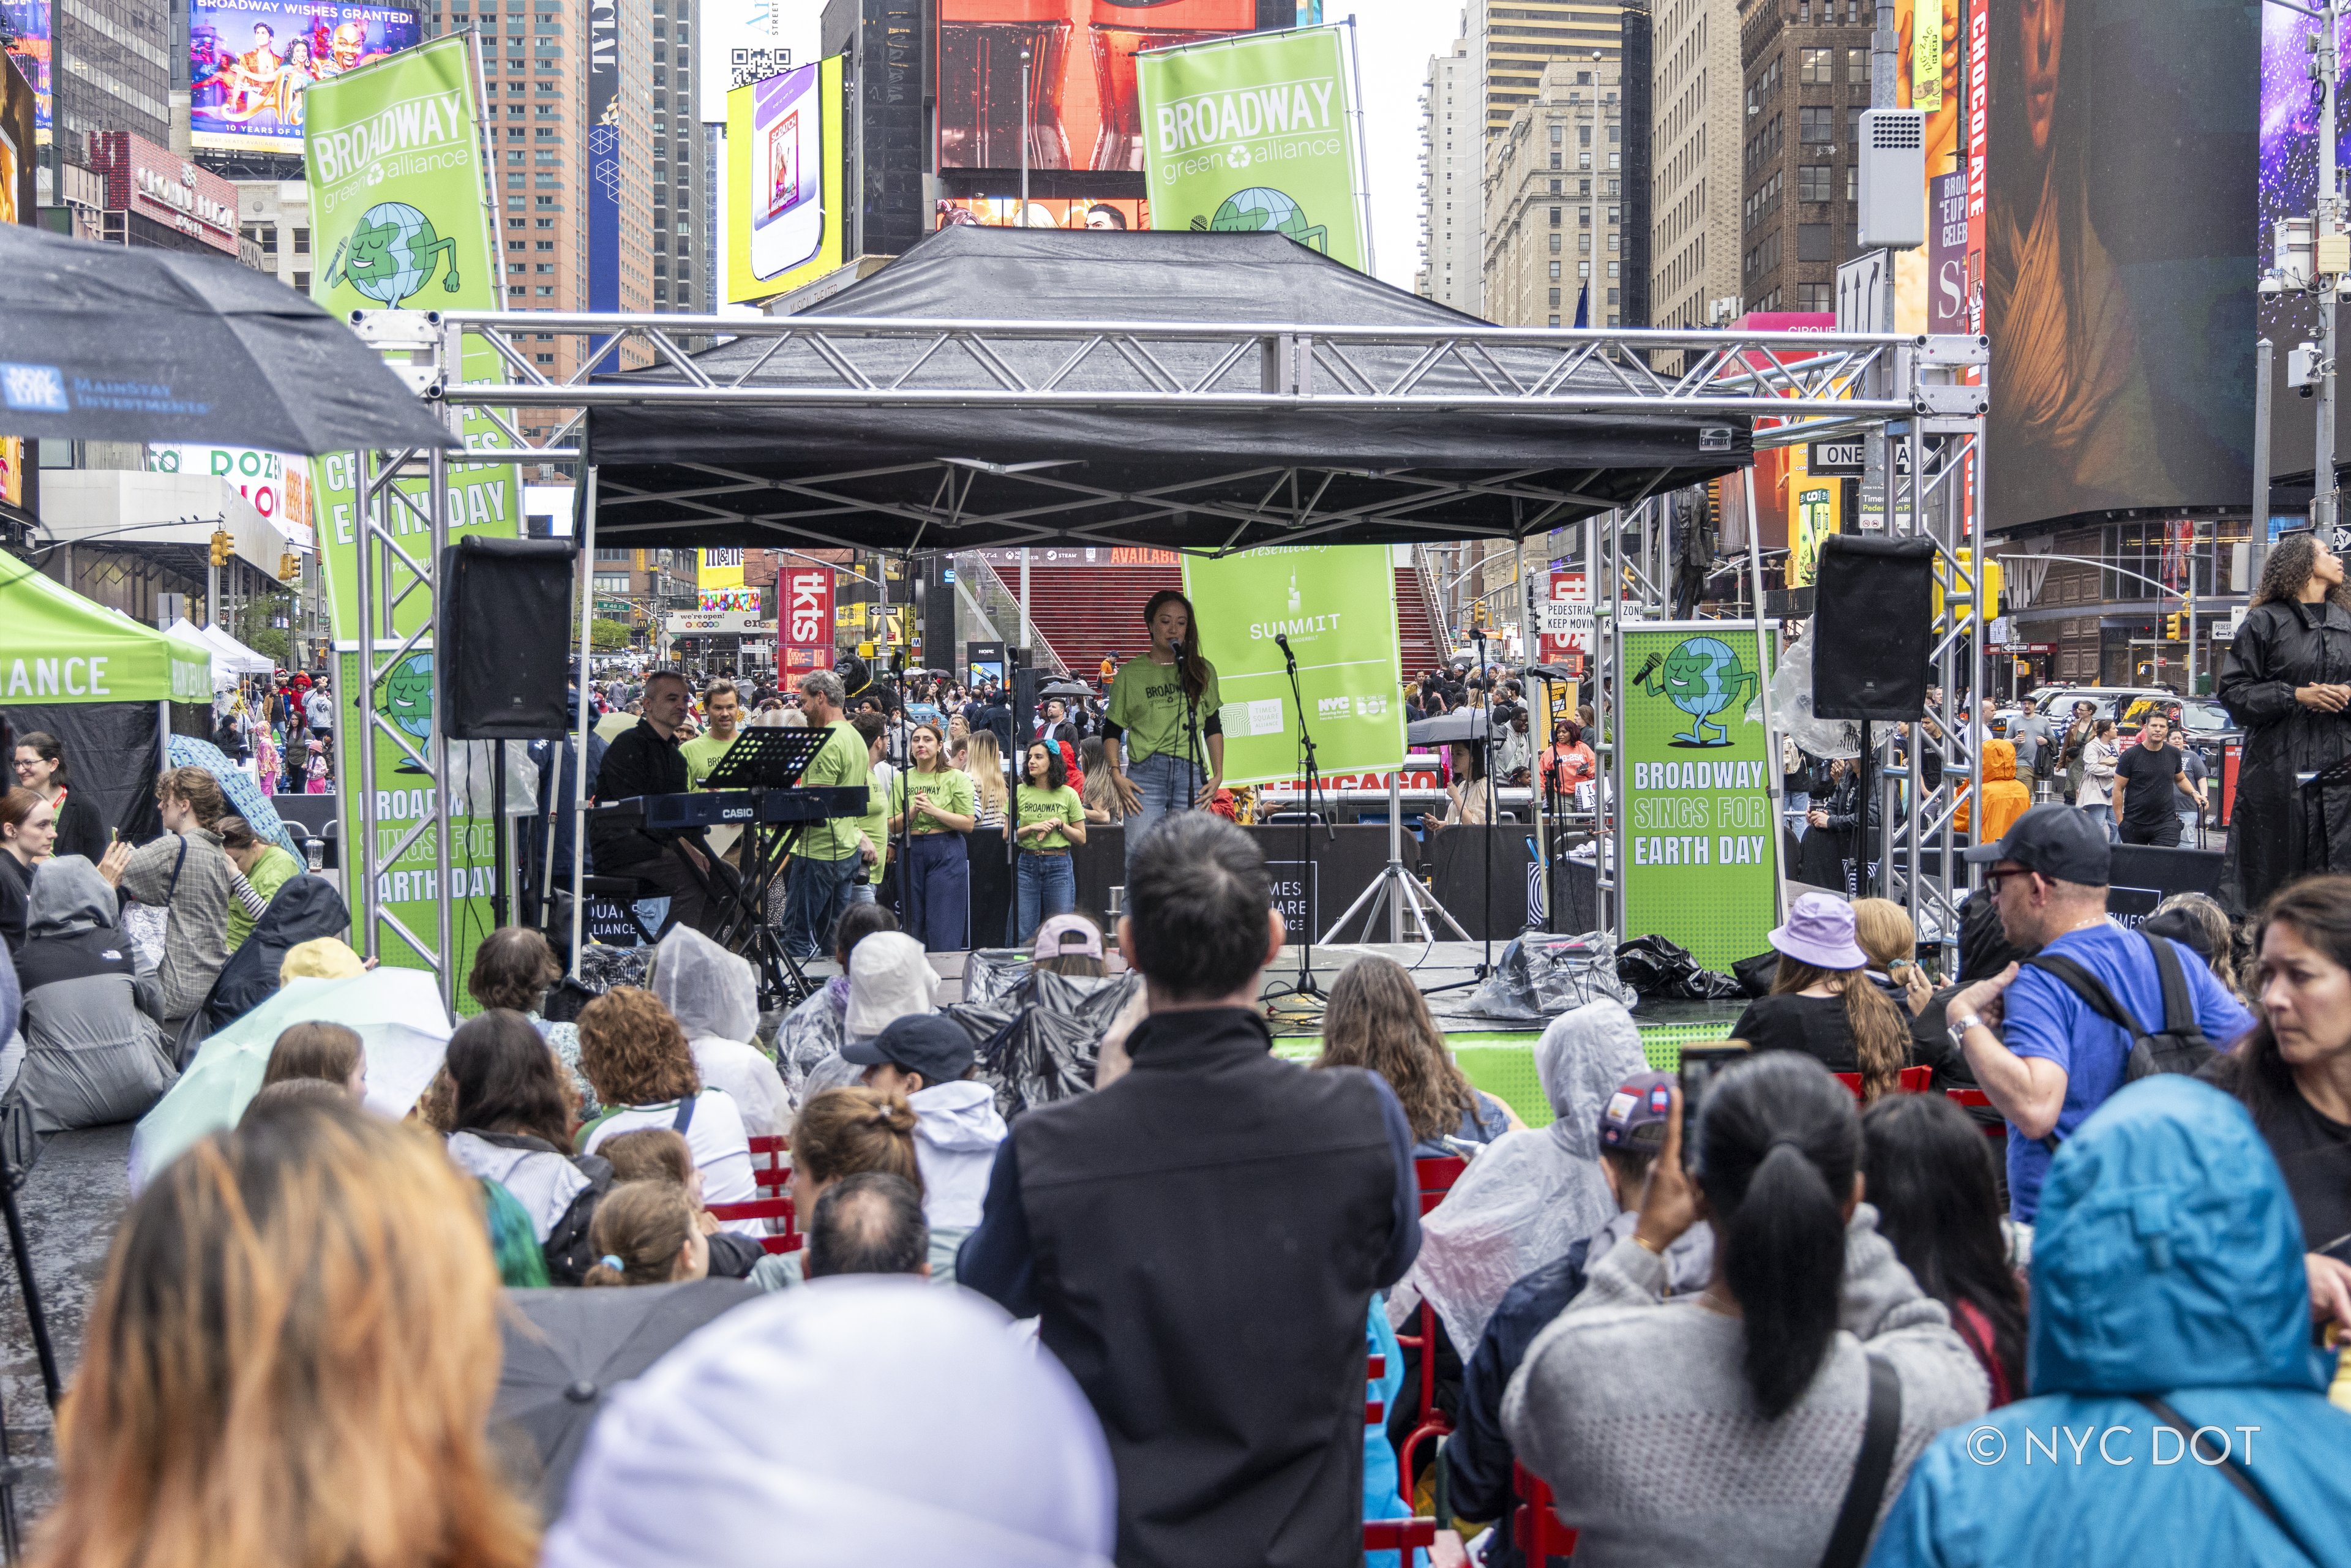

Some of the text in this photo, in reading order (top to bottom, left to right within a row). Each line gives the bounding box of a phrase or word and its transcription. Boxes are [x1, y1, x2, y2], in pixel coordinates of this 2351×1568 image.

[197, 0, 412, 24] BROADWAY WISHES GRANTED!
[1919, 24, 1933, 73] ZIG-ZAG
[1157, 81, 1333, 152] BROADWAY
[1970, 10, 1987, 217] CHOCOLATE
[241, 125, 273, 134] YEARS
[312, 92, 461, 183] BROADWAY
[1163, 138, 1340, 185] green alliance
[324, 149, 468, 213] green alliance
[790, 295, 811, 313] MUSICAL
[1700, 437, 1727, 446] Eurmax
[211, 450, 282, 481] DOZEN
[1827, 446, 1864, 463] ONE
[241, 485, 282, 520] OW
[448, 480, 506, 528] DAY
[1806, 492, 1818, 501] 6
[2333, 533, 2349, 544] AY
[1111, 547, 1181, 564] AVAILABL
[792, 572, 827, 642] tkts
[1548, 605, 1641, 615] PEDESTRIA ZONE
[1250, 613, 1341, 640] SUMMIT
[1548, 618, 1593, 628] KEEP MOVIN
[1288, 635, 1318, 643] VANDERBILT
[0, 656, 110, 697] ANCE
[1318, 696, 1350, 711] NYC
[1356, 700, 1387, 715] DOT
[1253, 713, 1280, 722] SQUARE
[1634, 760, 1764, 790] BROADWAY
[907, 786, 941, 797] BROADWAY
[722, 808, 753, 819] CASIO
[1024, 803, 1061, 813] BROADWAY
[1634, 797, 1765, 828] SINGS FOR
[450, 823, 496, 860] FOR
[1634, 835, 1765, 865] EARTH DAY
[452, 865, 497, 898] DAY
[590, 923, 637, 934] LIANCE
